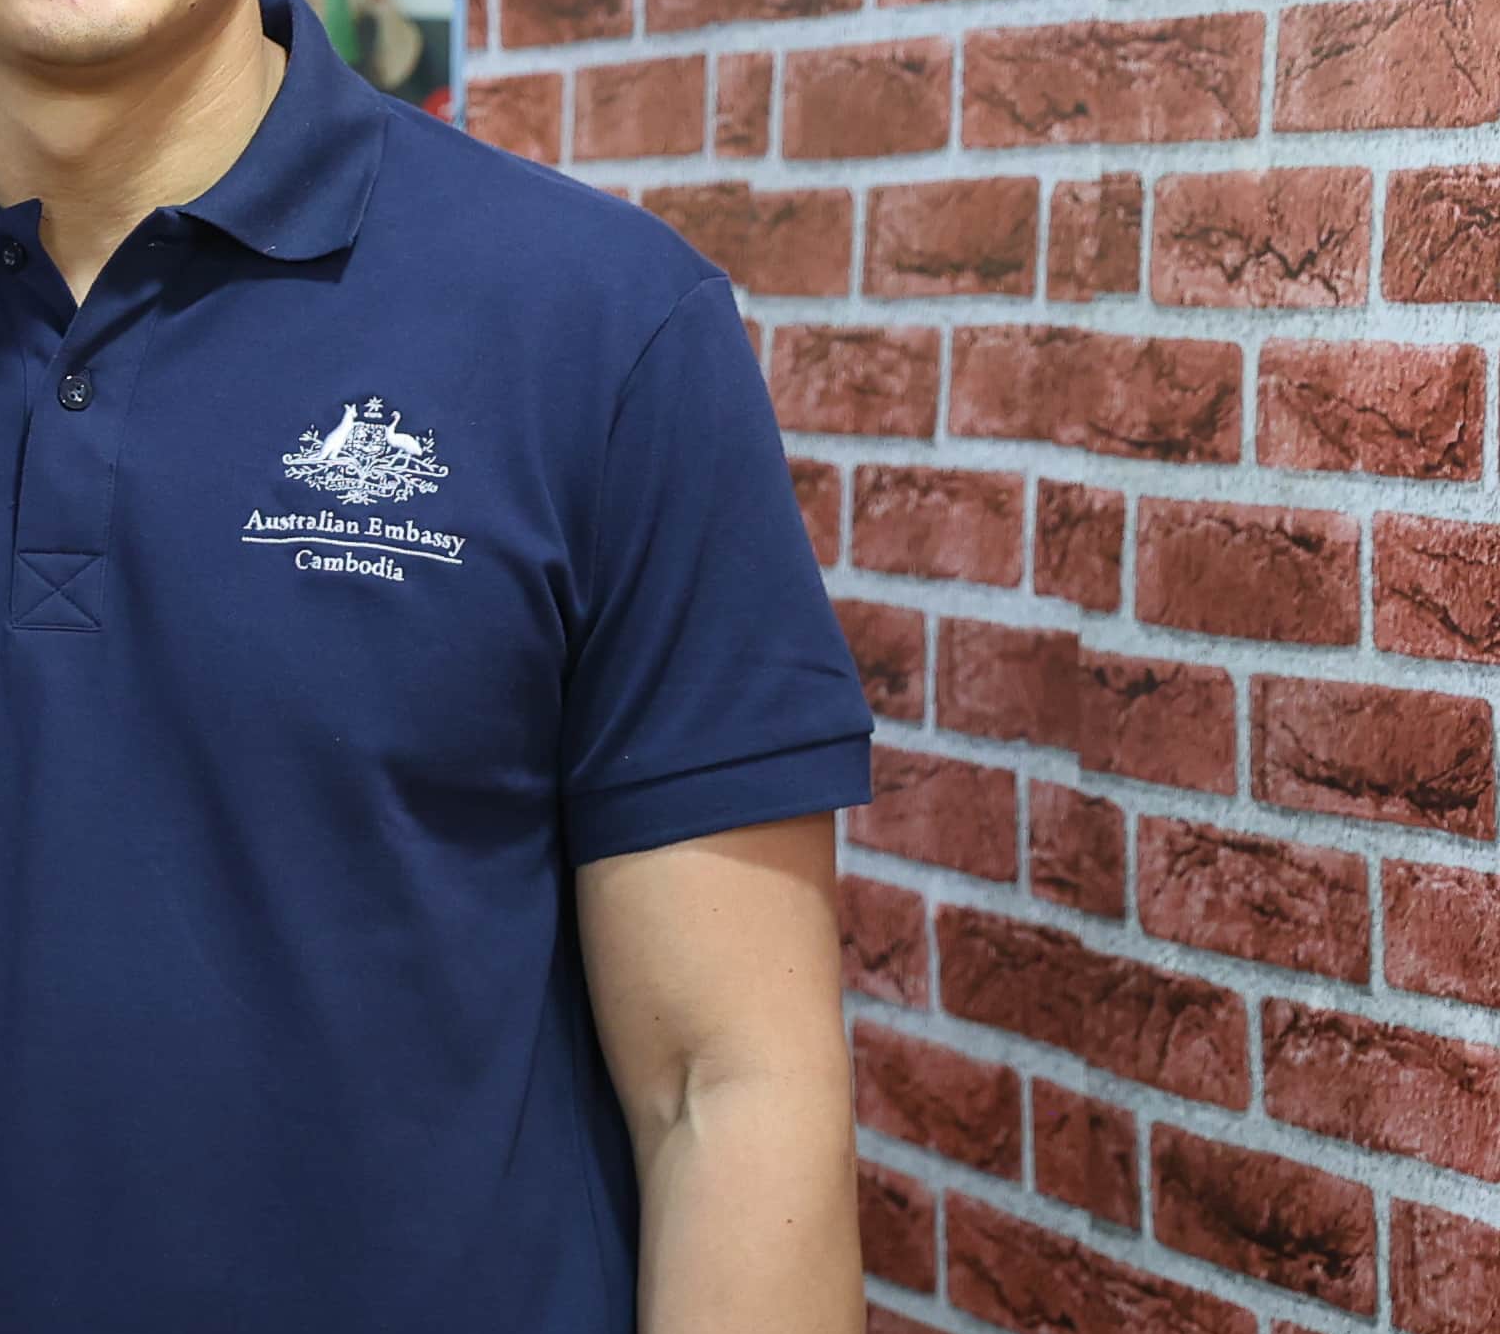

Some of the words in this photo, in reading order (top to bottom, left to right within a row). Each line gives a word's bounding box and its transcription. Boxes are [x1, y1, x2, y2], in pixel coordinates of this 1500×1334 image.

[244, 509, 360, 535] Australian
[363, 517, 466, 557] Embassy
[295, 549, 404, 582] Cambodia
